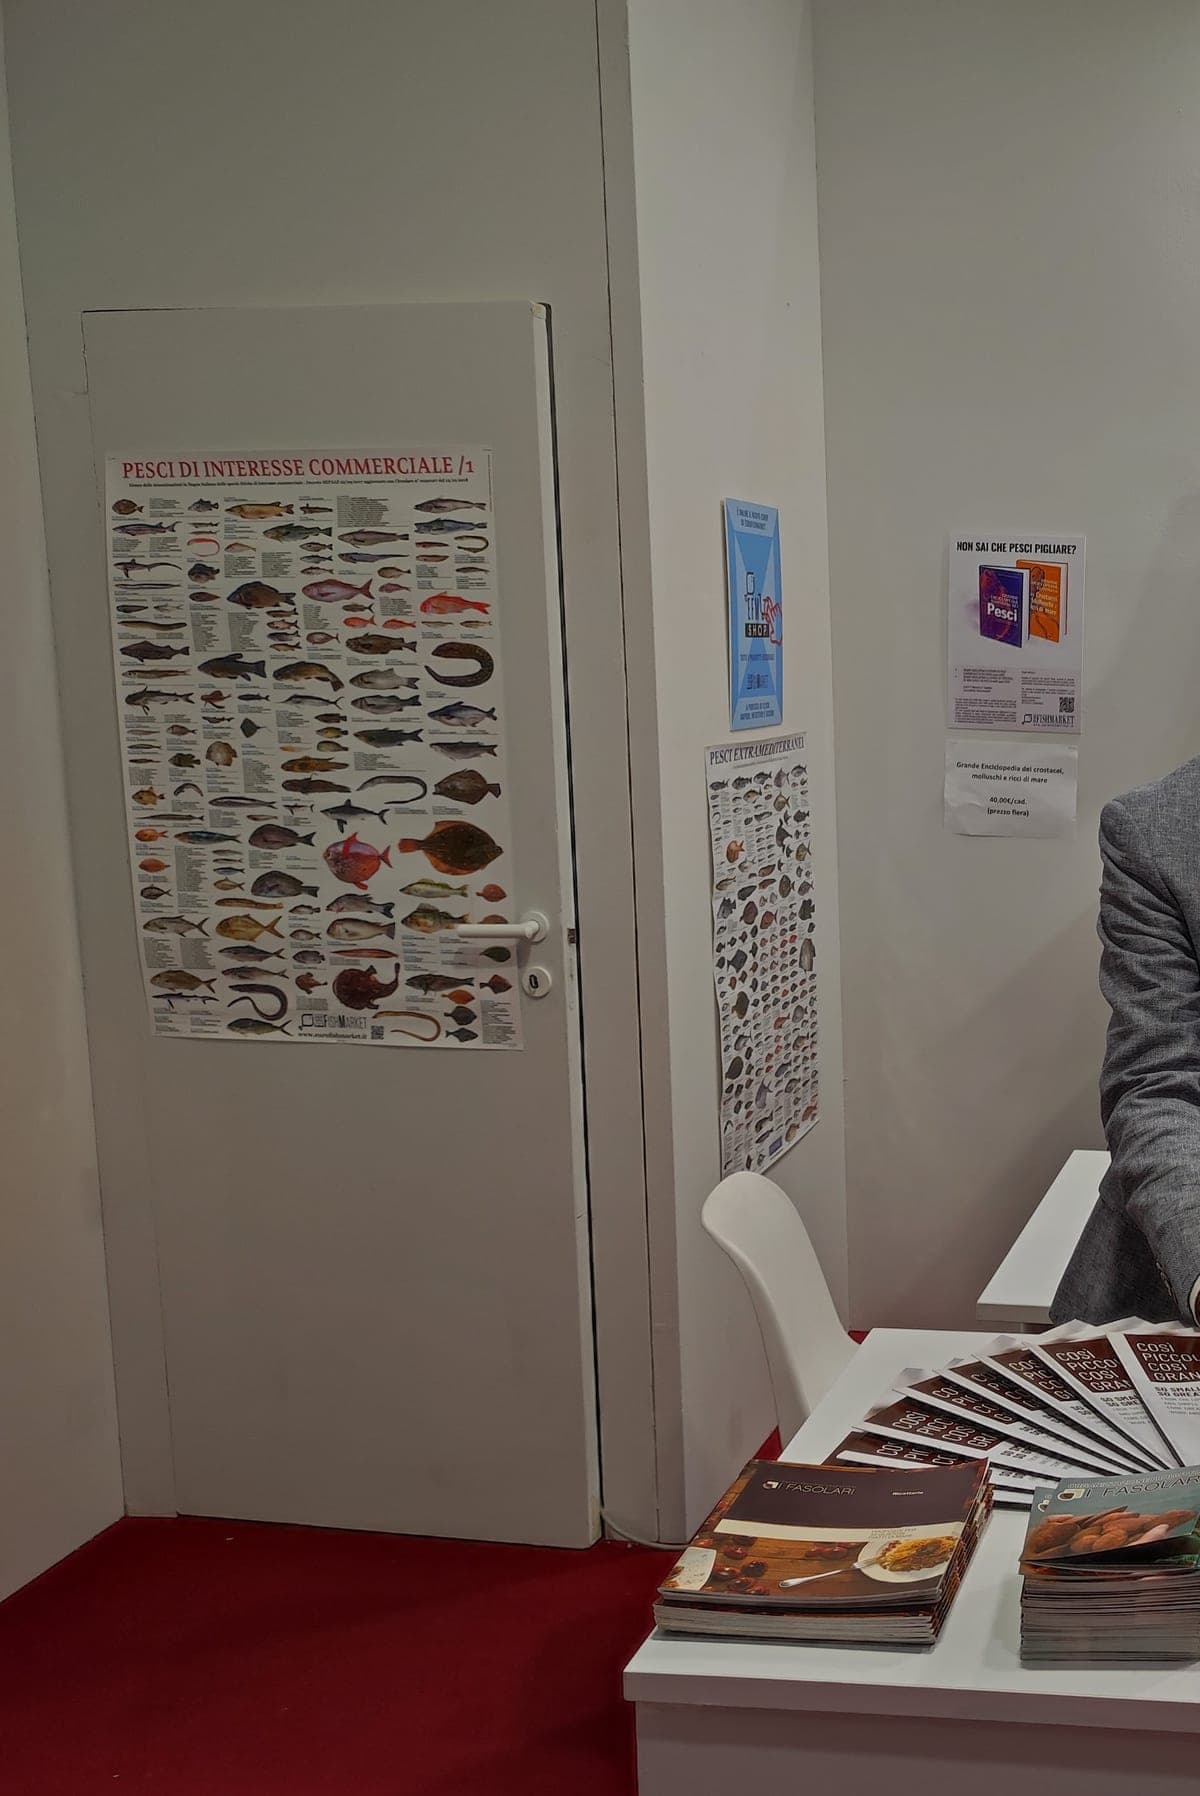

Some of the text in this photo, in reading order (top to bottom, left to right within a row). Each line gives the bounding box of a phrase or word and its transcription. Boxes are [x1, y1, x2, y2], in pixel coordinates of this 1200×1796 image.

[122, 455, 475, 479] PESCI DI INTERESSE COMMERCIALE /1
[956, 541, 1077, 555] NON SAI CHE PESCI PIGLIARE?
[986, 602, 1018, 622] Pesci
[747, 623, 768, 637] SHOP
[709, 736, 806, 766] PESCI EXTRAMEDITERRANEI
[956, 761, 980, 769] Grande
[981, 762, 1021, 772] Enciclopedia
[1032, 766, 1064, 776] crostacei,
[971, 773, 1002, 781] molluschi
[989, 796, 1027, 805] 40,00€/cad.
[987, 807, 1030, 818] (prezzo fiera)
[1136, 1341, 1175, 1353] COSÌ
[1055, 1348, 1096, 1362] COSÌ
[1066, 1358, 1120, 1372] PICCO
[1147, 1360, 1188, 1372] COSÌ
[1078, 1367, 1120, 1381] COSÌ
[786, 1483, 856, 1496] FASOLARI
